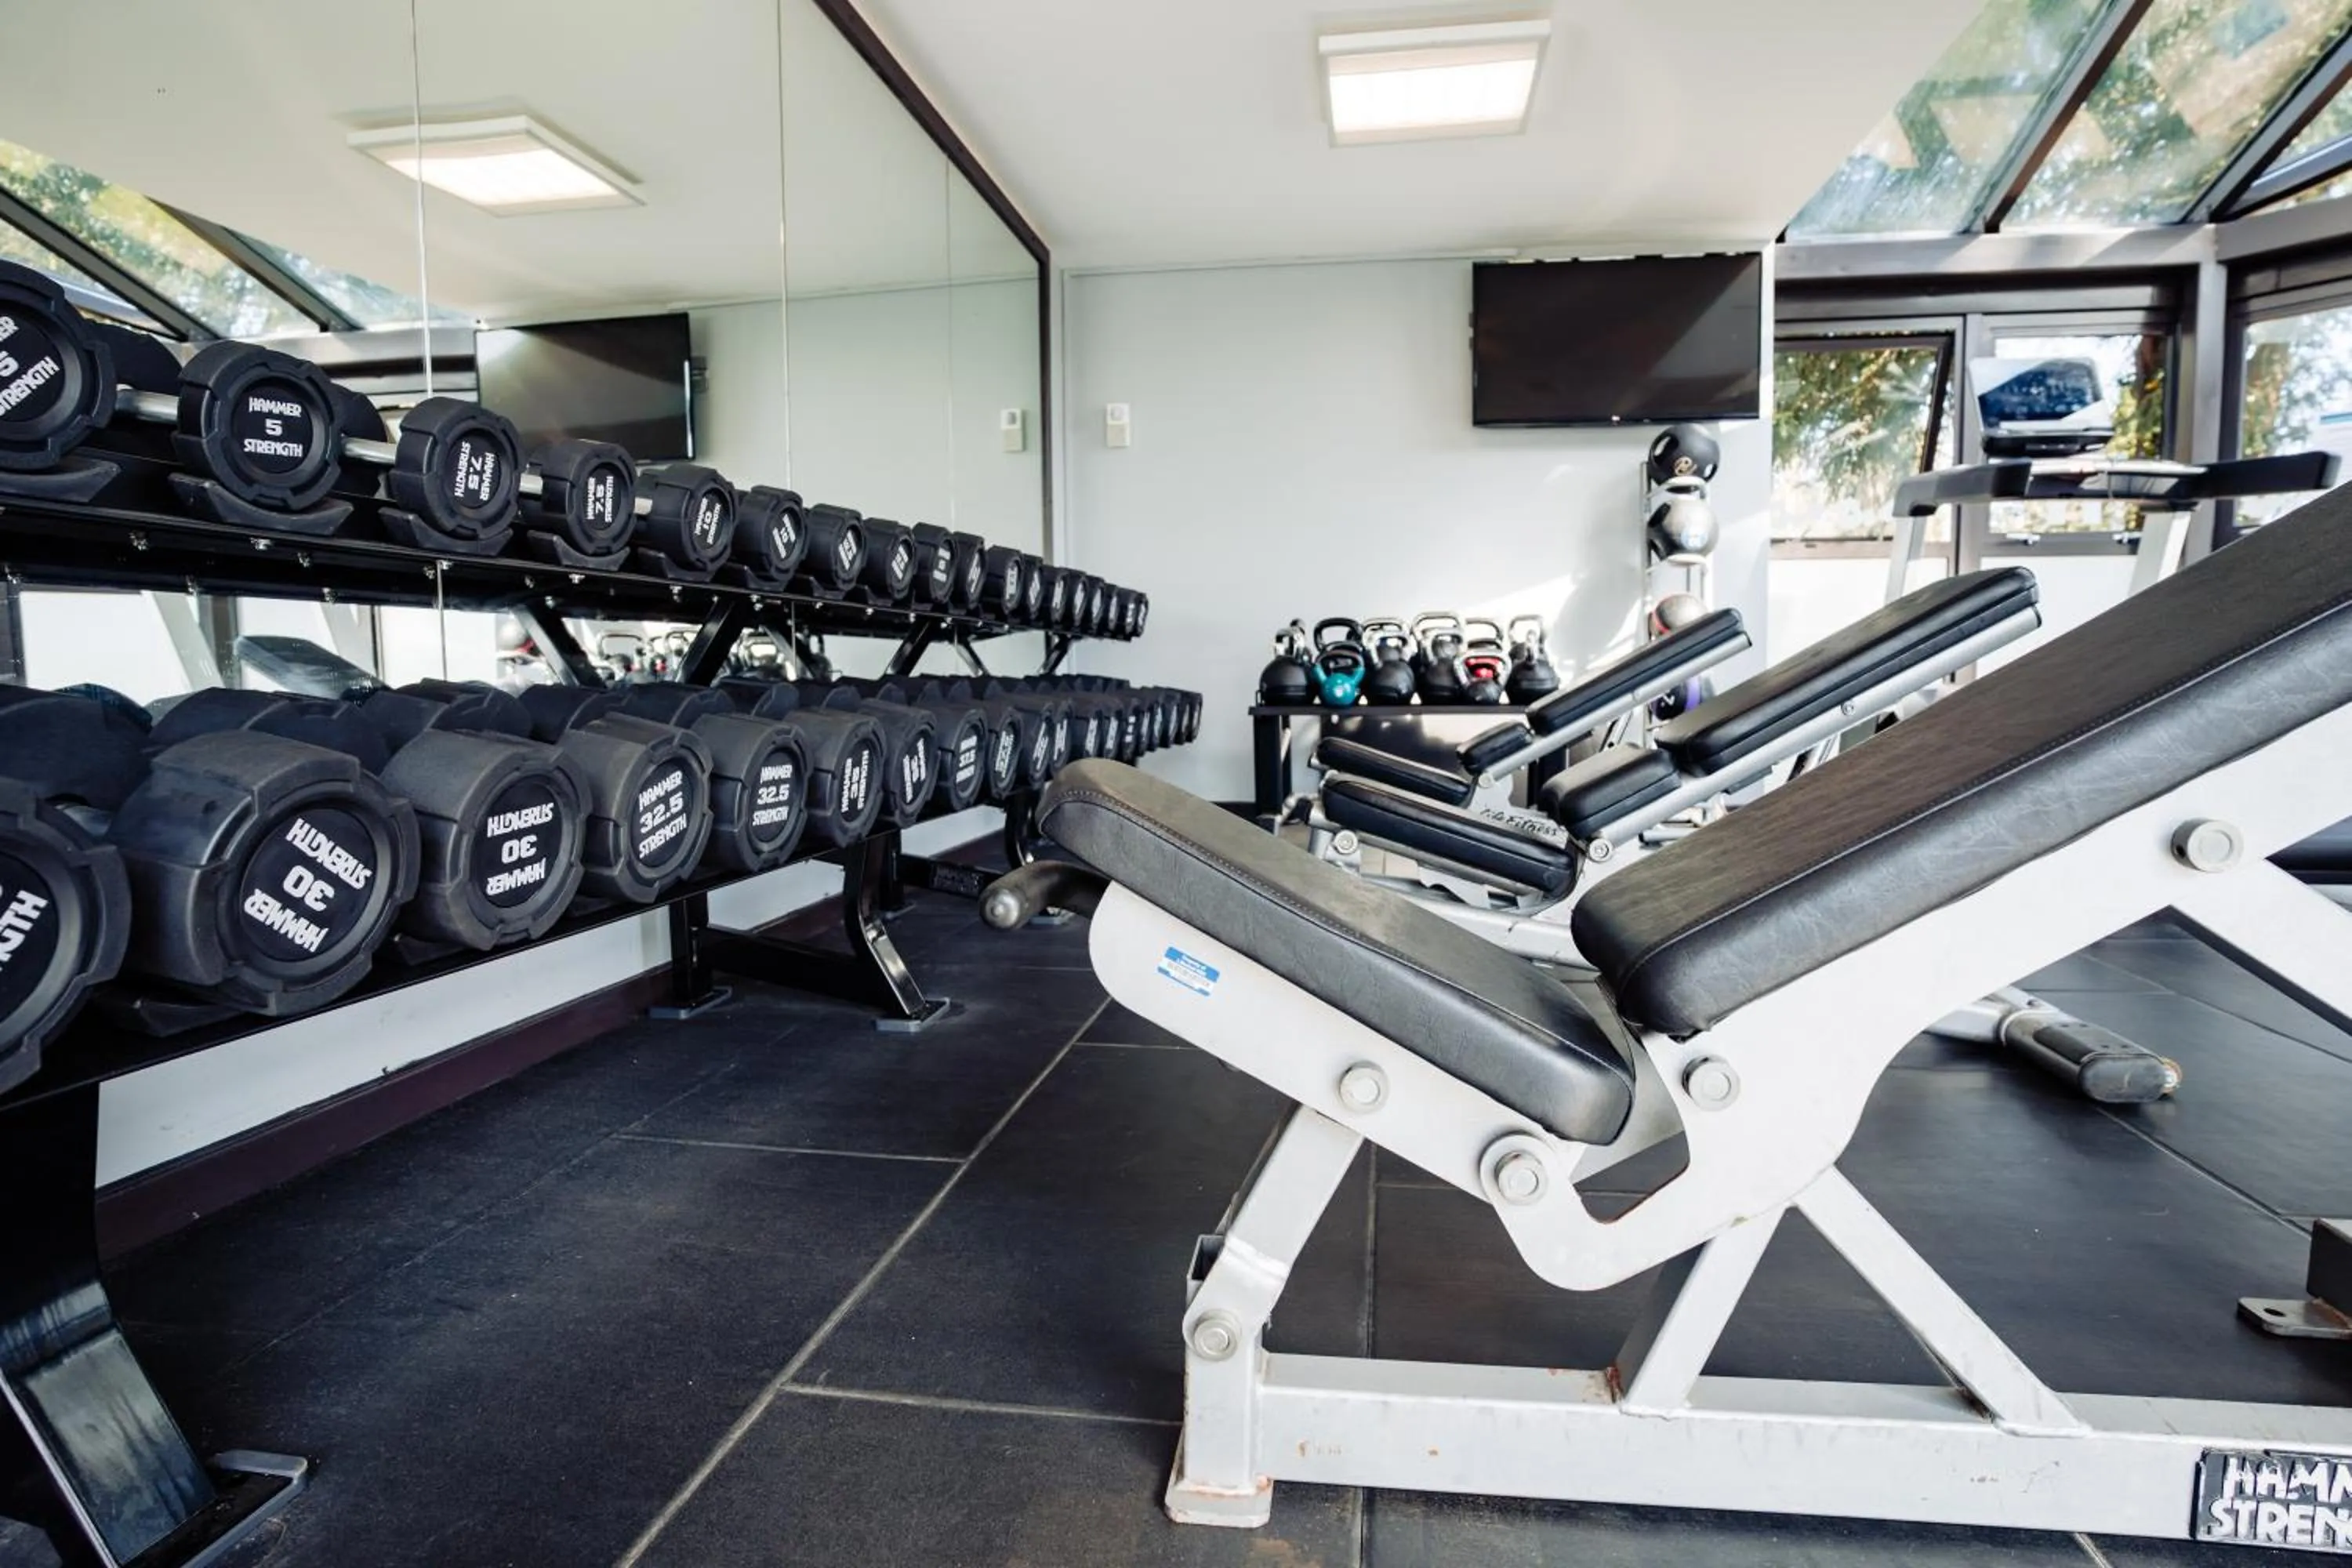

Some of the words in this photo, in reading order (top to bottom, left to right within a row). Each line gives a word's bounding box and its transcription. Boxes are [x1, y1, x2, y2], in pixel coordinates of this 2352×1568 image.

[249, 396, 302, 417] HAMMER
[265, 418, 283, 436] 5
[244, 438, 303, 457] STRENGTH
[455, 441, 471, 498] STRENGTH
[468, 456, 482, 490] 7.5
[479, 452, 495, 501] HAMMER
[596, 484, 604, 514] 7.5
[639, 771, 683, 812] HAMMER
[757, 784, 789, 805] 32.5
[487, 802, 554, 838] STRENGTH
[640, 791, 683, 833] 32.5
[285, 818, 372, 889] STRENGTH
[502, 834, 537, 864] 30
[639, 813, 688, 858] STRENGTH
[283, 865, 335, 912] 30
[486, 857, 546, 895] HAMMER
[244, 888, 329, 953] HAMMER
[2209, 1497, 2352, 1550] STREN
